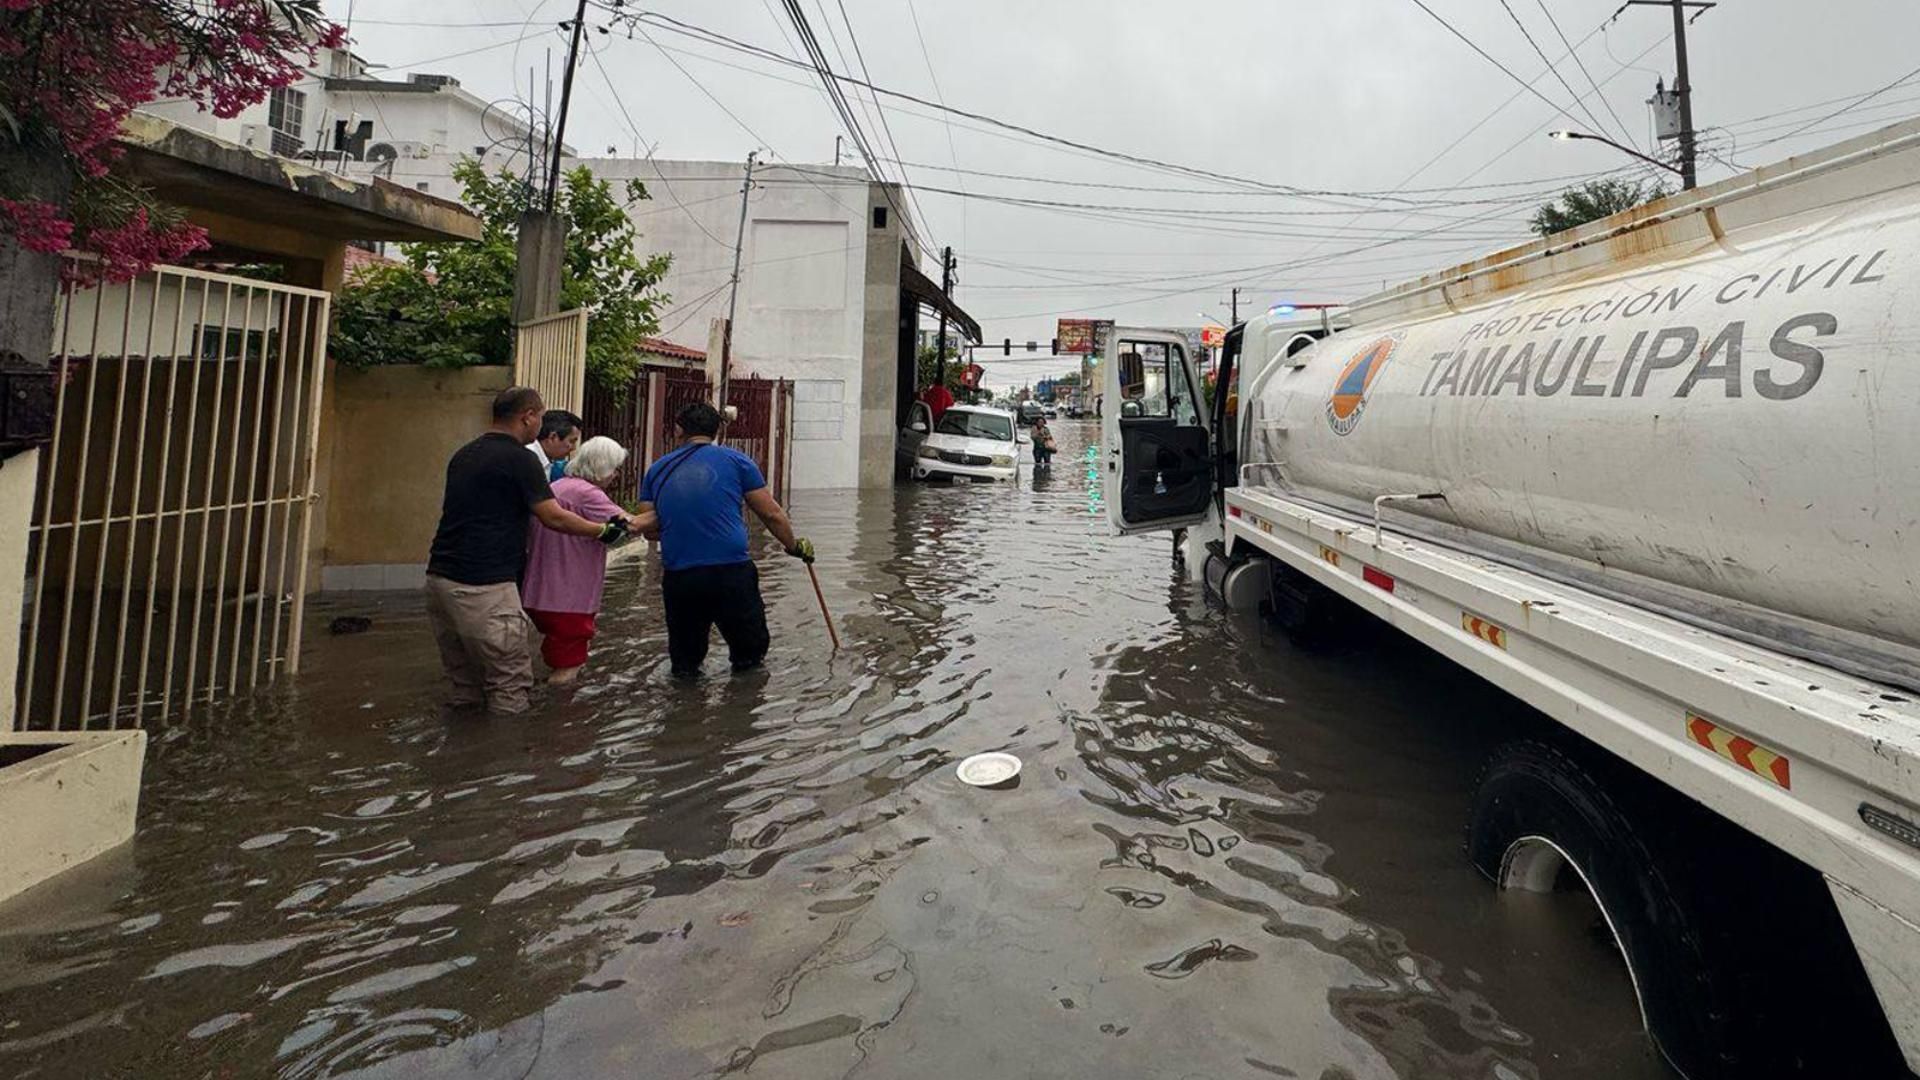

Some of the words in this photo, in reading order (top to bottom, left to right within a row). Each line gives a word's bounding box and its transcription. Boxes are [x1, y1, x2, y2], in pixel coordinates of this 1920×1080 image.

[1460, 284, 1696, 343] PROTECCIÓN
[1715, 249, 1887, 305] CIVIL
[1419, 312, 1838, 401] TAMAULIPAS
